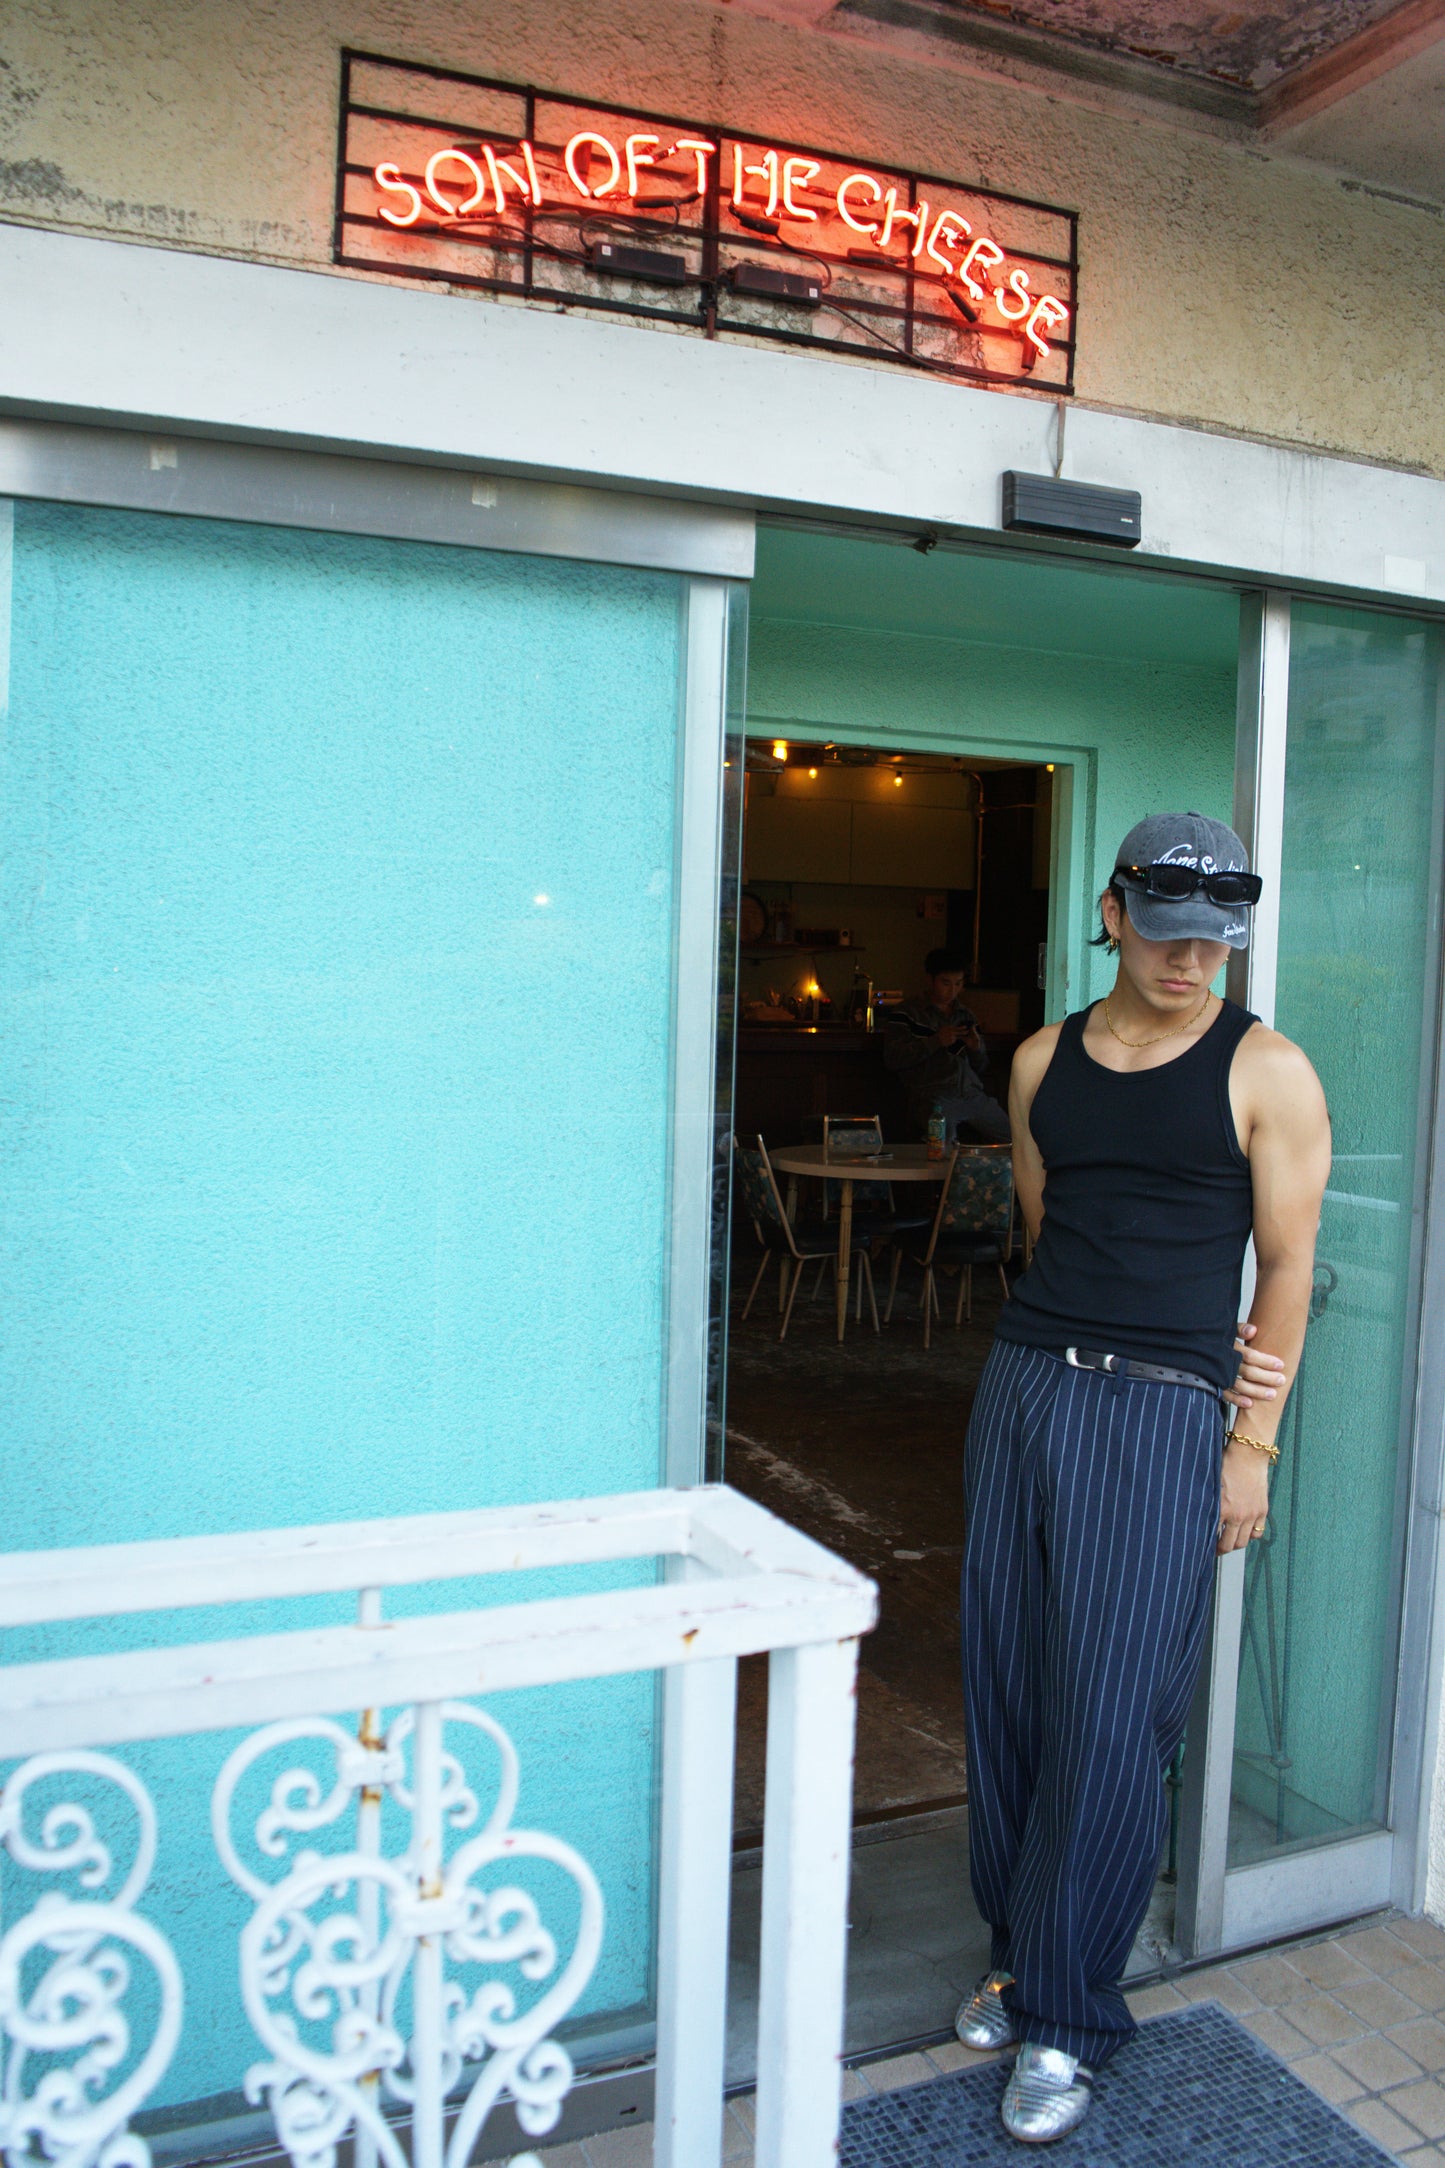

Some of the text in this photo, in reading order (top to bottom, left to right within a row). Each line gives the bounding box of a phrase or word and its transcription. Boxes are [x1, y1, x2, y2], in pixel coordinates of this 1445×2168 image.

[373, 131, 1070, 358] SON OF THE CHEESE
[1201, 855, 1243, 875] Stdi
